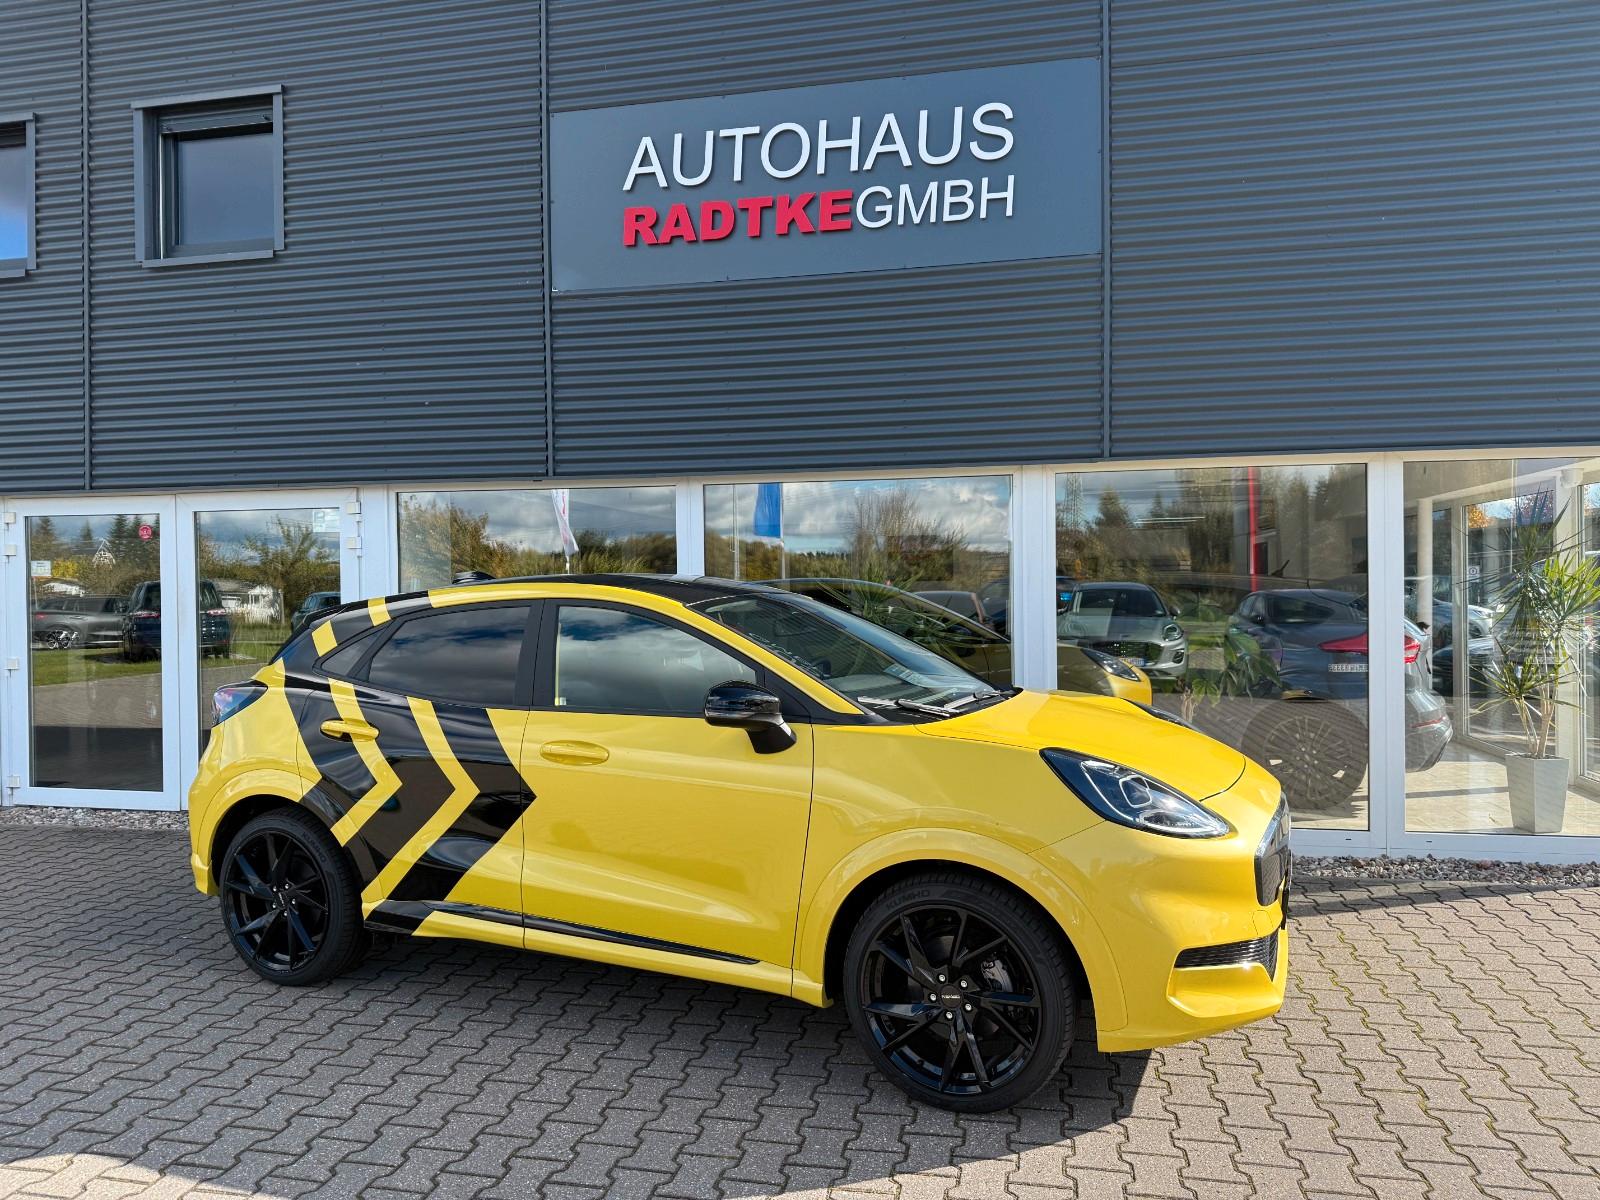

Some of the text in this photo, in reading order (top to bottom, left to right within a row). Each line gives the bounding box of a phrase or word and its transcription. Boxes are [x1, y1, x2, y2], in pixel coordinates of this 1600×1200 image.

[623, 102, 1014, 191] AUTOHAUS
[623, 174, 1015, 246] RADTKE GMBH
